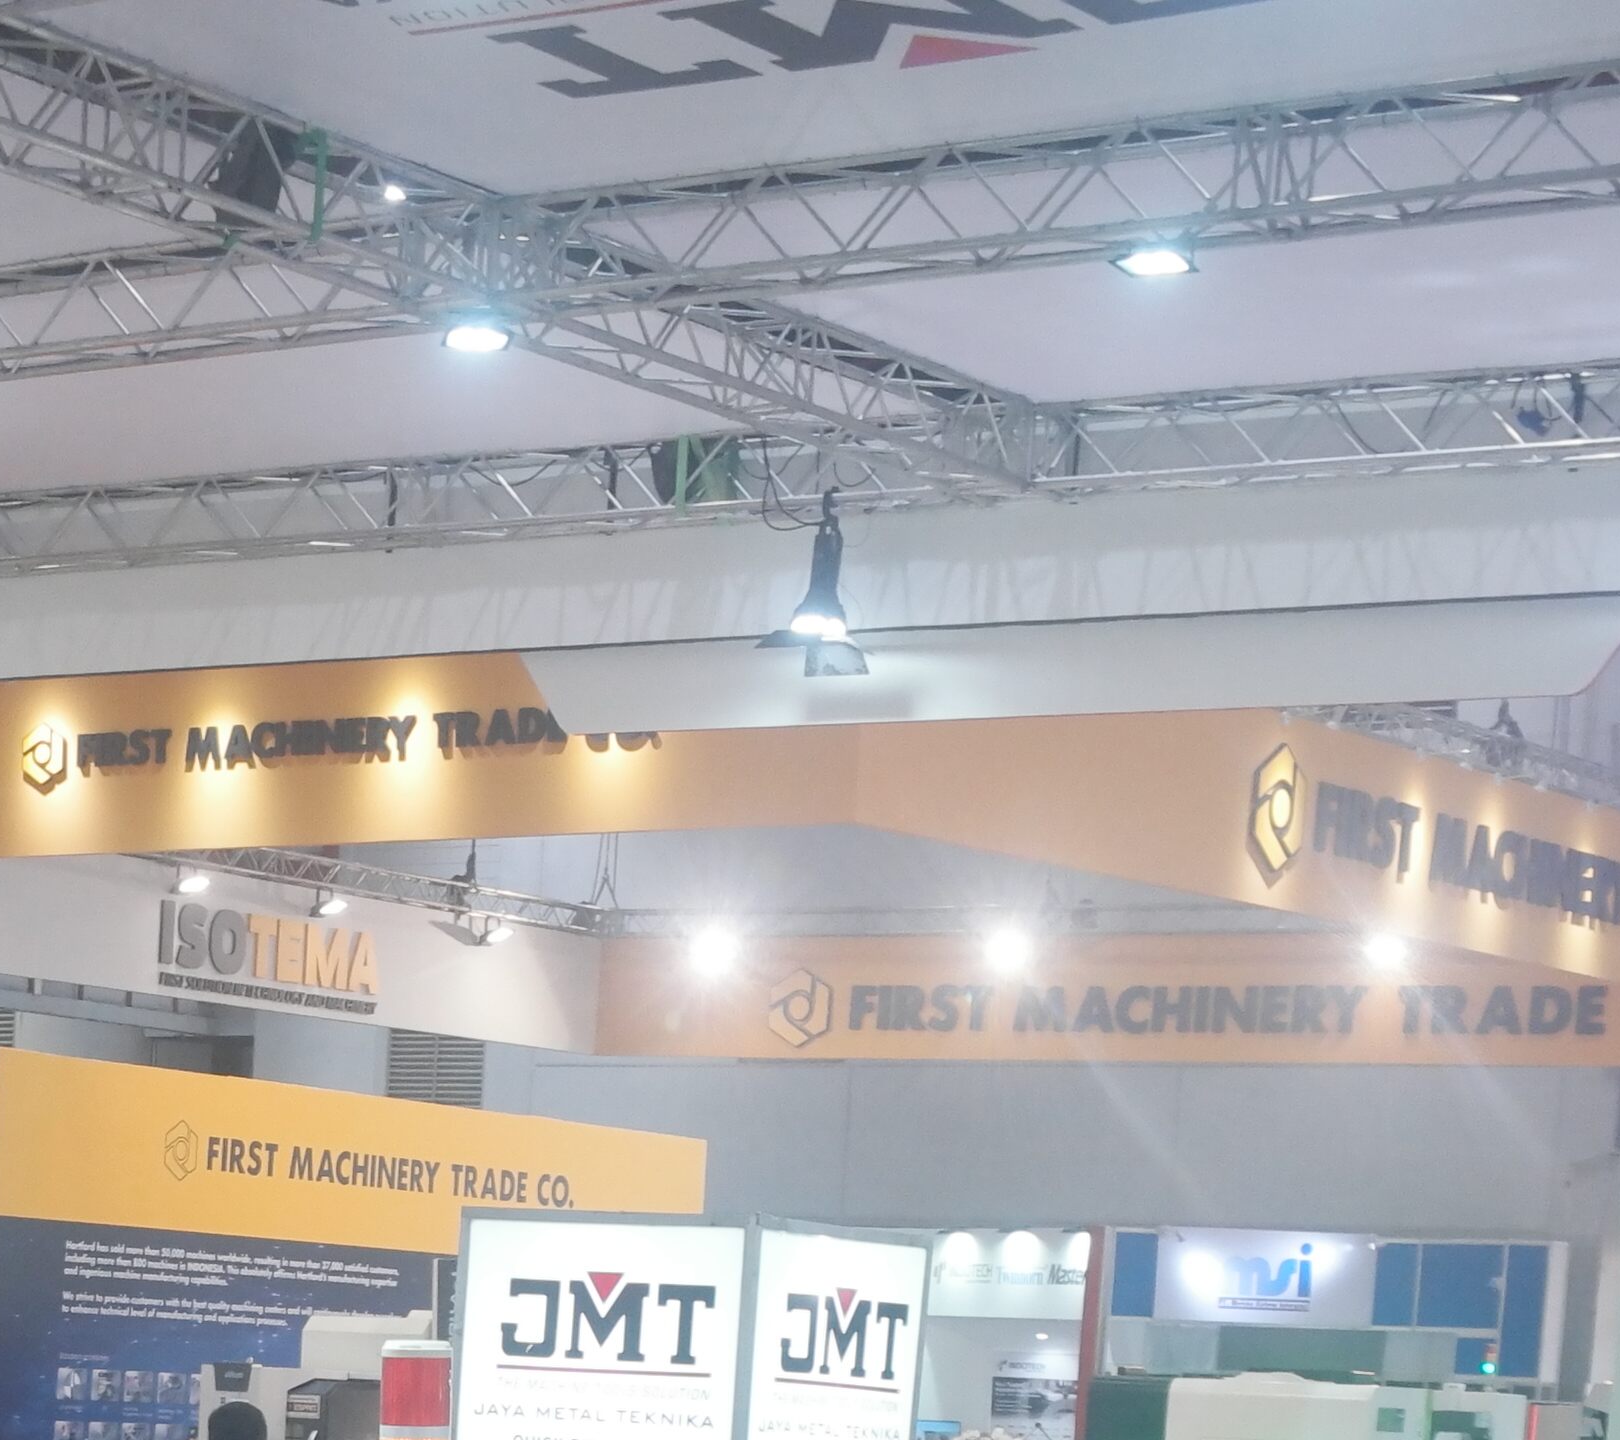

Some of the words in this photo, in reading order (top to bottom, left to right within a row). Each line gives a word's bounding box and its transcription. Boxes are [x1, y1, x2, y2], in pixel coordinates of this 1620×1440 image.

[76, 728, 173, 772] FIRST
[185, 715, 417, 773] MACHINERY
[1312, 780, 1424, 884] FIRST
[157, 899, 379, 996] ISOTEMA
[848, 982, 990, 1033] FIRST
[1011, 982, 1361, 1034] MACHINERY
[1397, 984, 1607, 1037] TRADE
[206, 1135, 279, 1178] FIRST
[288, 1145, 441, 1195] MACHINERY
[450, 1163, 529, 1204] TRADE
[537, 1173, 575, 1209] CO.
[500, 1271, 717, 1366] JMT
[779, 1287, 909, 1381] JMT
[473, 1402, 525, 1418] JAYA
[536, 1406, 606, 1423] METAL
[616, 1409, 715, 1429] TEKNIKA
[641, 1385, 712, 1401] SOLUTION
[758, 1420, 792, 1433] JAYA
[846, 1425, 900, 1440] TEKNIKA
